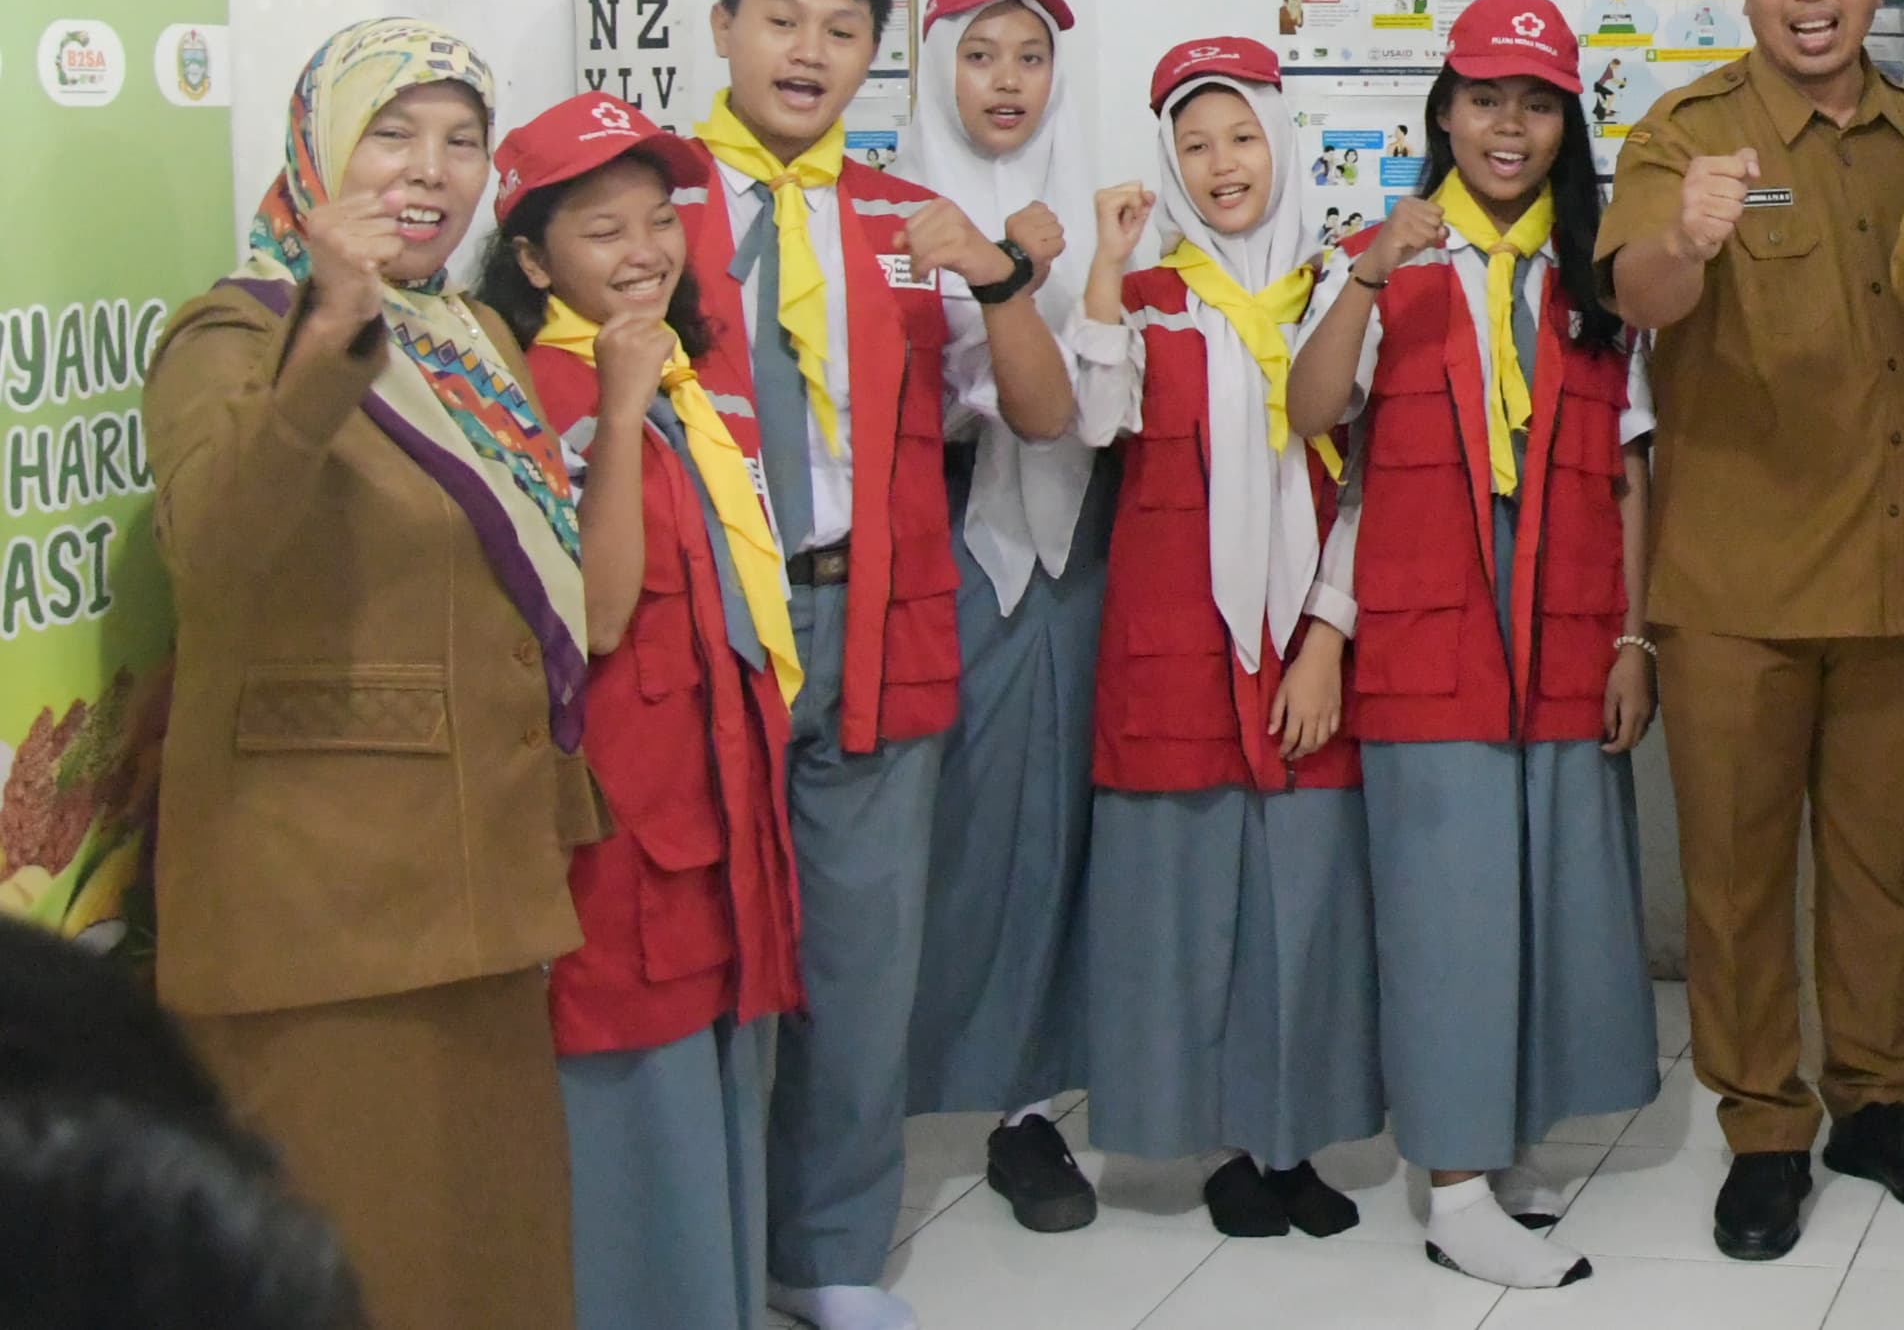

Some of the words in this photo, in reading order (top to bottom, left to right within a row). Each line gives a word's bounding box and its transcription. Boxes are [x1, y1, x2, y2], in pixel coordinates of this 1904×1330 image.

[67, 50, 106, 67] B2SA
[617, 67, 642, 110] L
[651, 66, 676, 110] V
[0, 302, 166, 407] YANG
[3, 521, 113, 634] ASI
